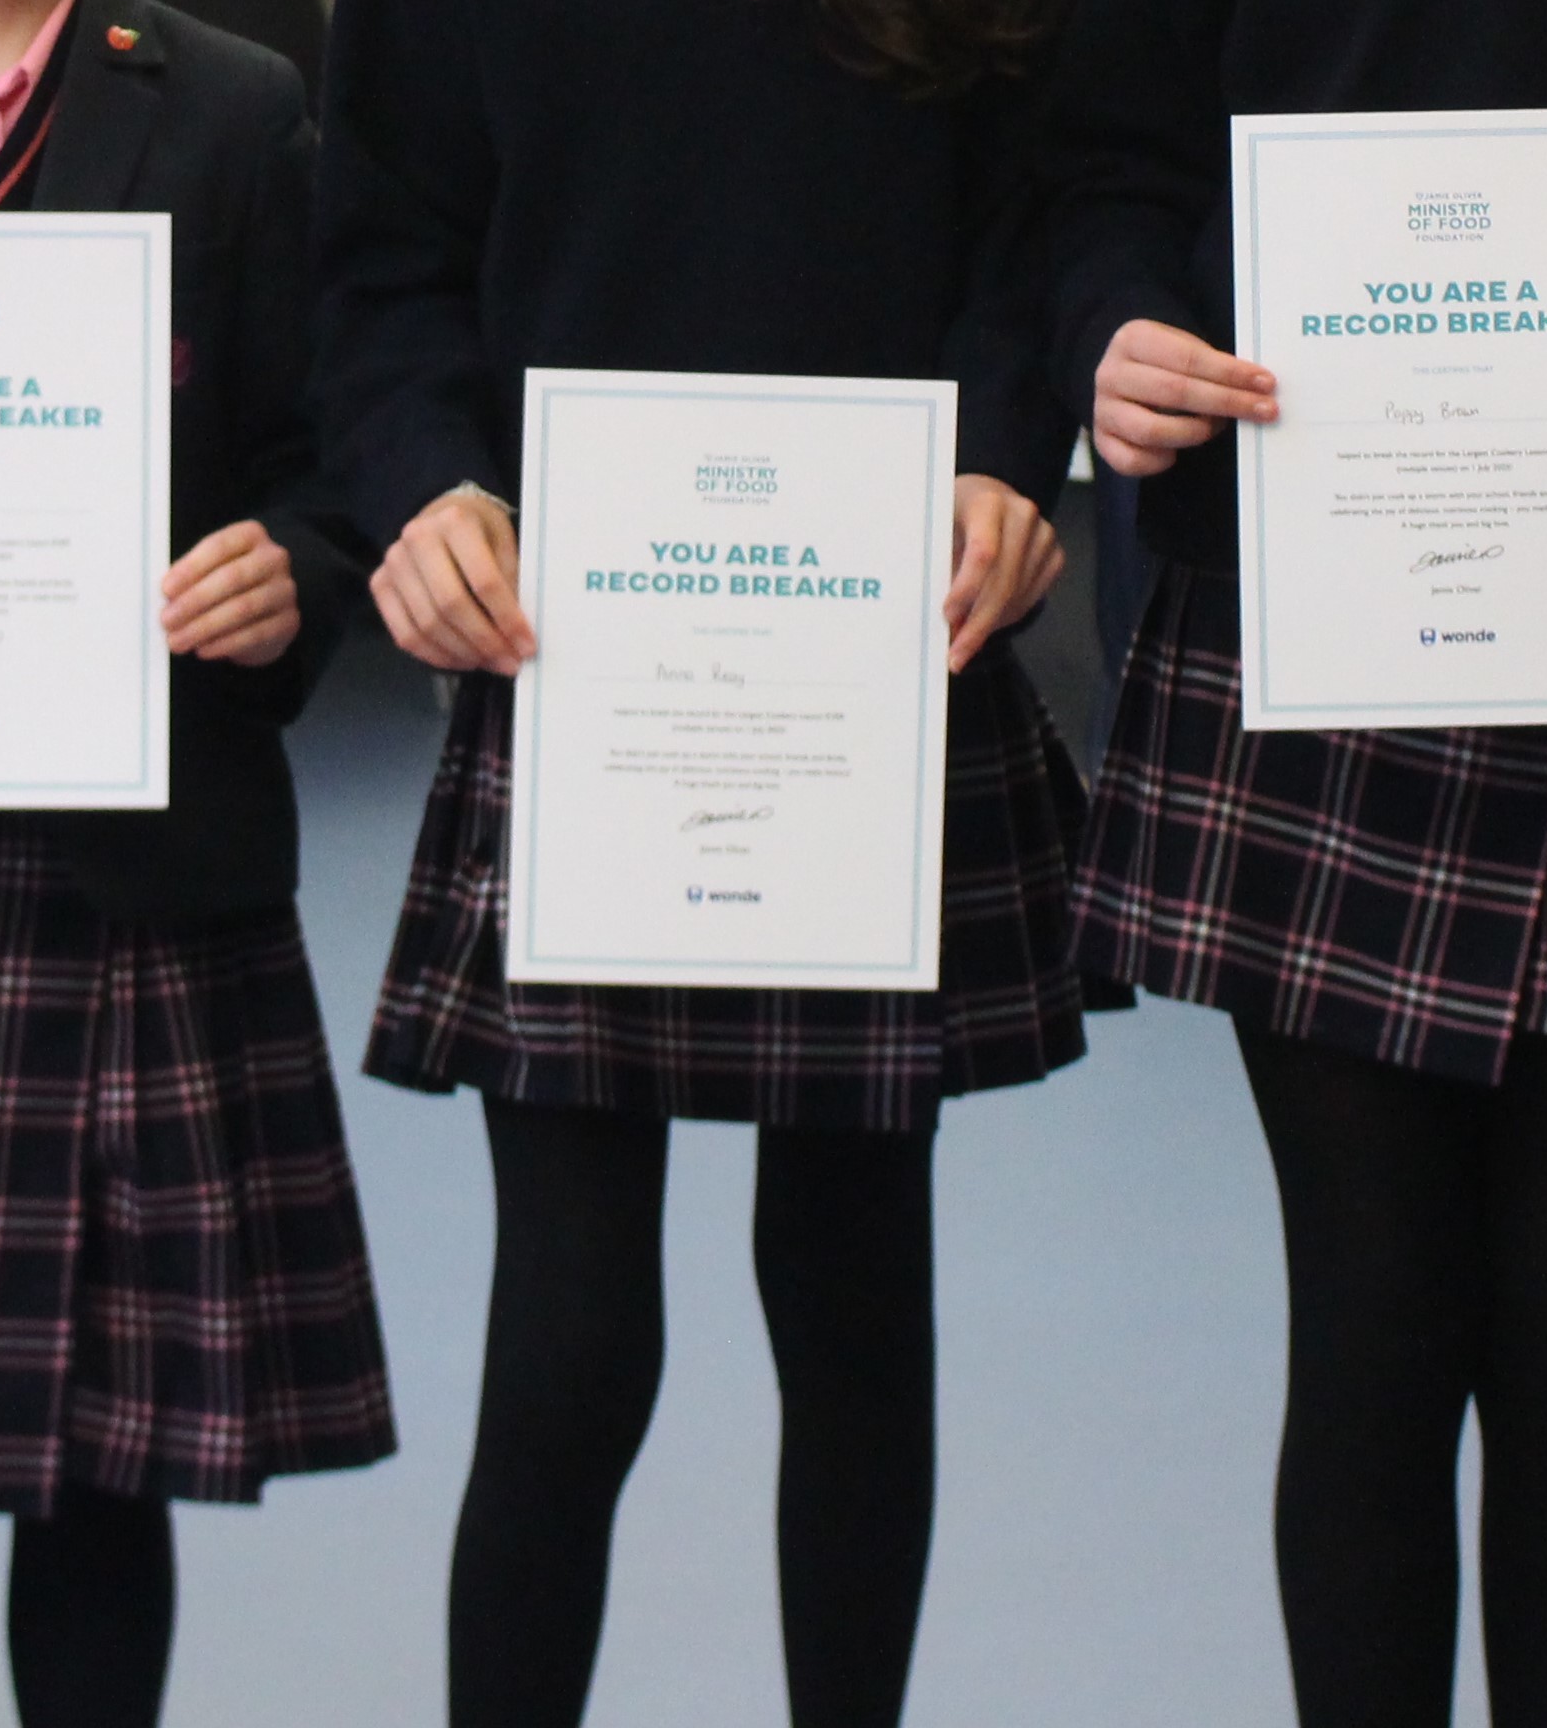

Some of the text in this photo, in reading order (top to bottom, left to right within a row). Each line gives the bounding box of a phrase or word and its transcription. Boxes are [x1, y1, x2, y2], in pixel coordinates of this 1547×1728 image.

[1408, 203, 1490, 216] MINISTRY
[1408, 217, 1491, 230] OF FOOD
[1415, 233, 1485, 242] FOUNDATION
[1364, 280, 1538, 304] YOU ARE A
[1302, 313, 1438, 336] RECORD
[21, 377, 41, 397] A
[696, 465, 778, 480] MINISTRY
[695, 480, 778, 494] OF FOOD
[650, 542, 819, 567] YOU ARE A
[586, 570, 881, 599] RECORD BREAKER
[1441, 628, 1496, 643] wonde
[708, 890, 761, 904] wonde
